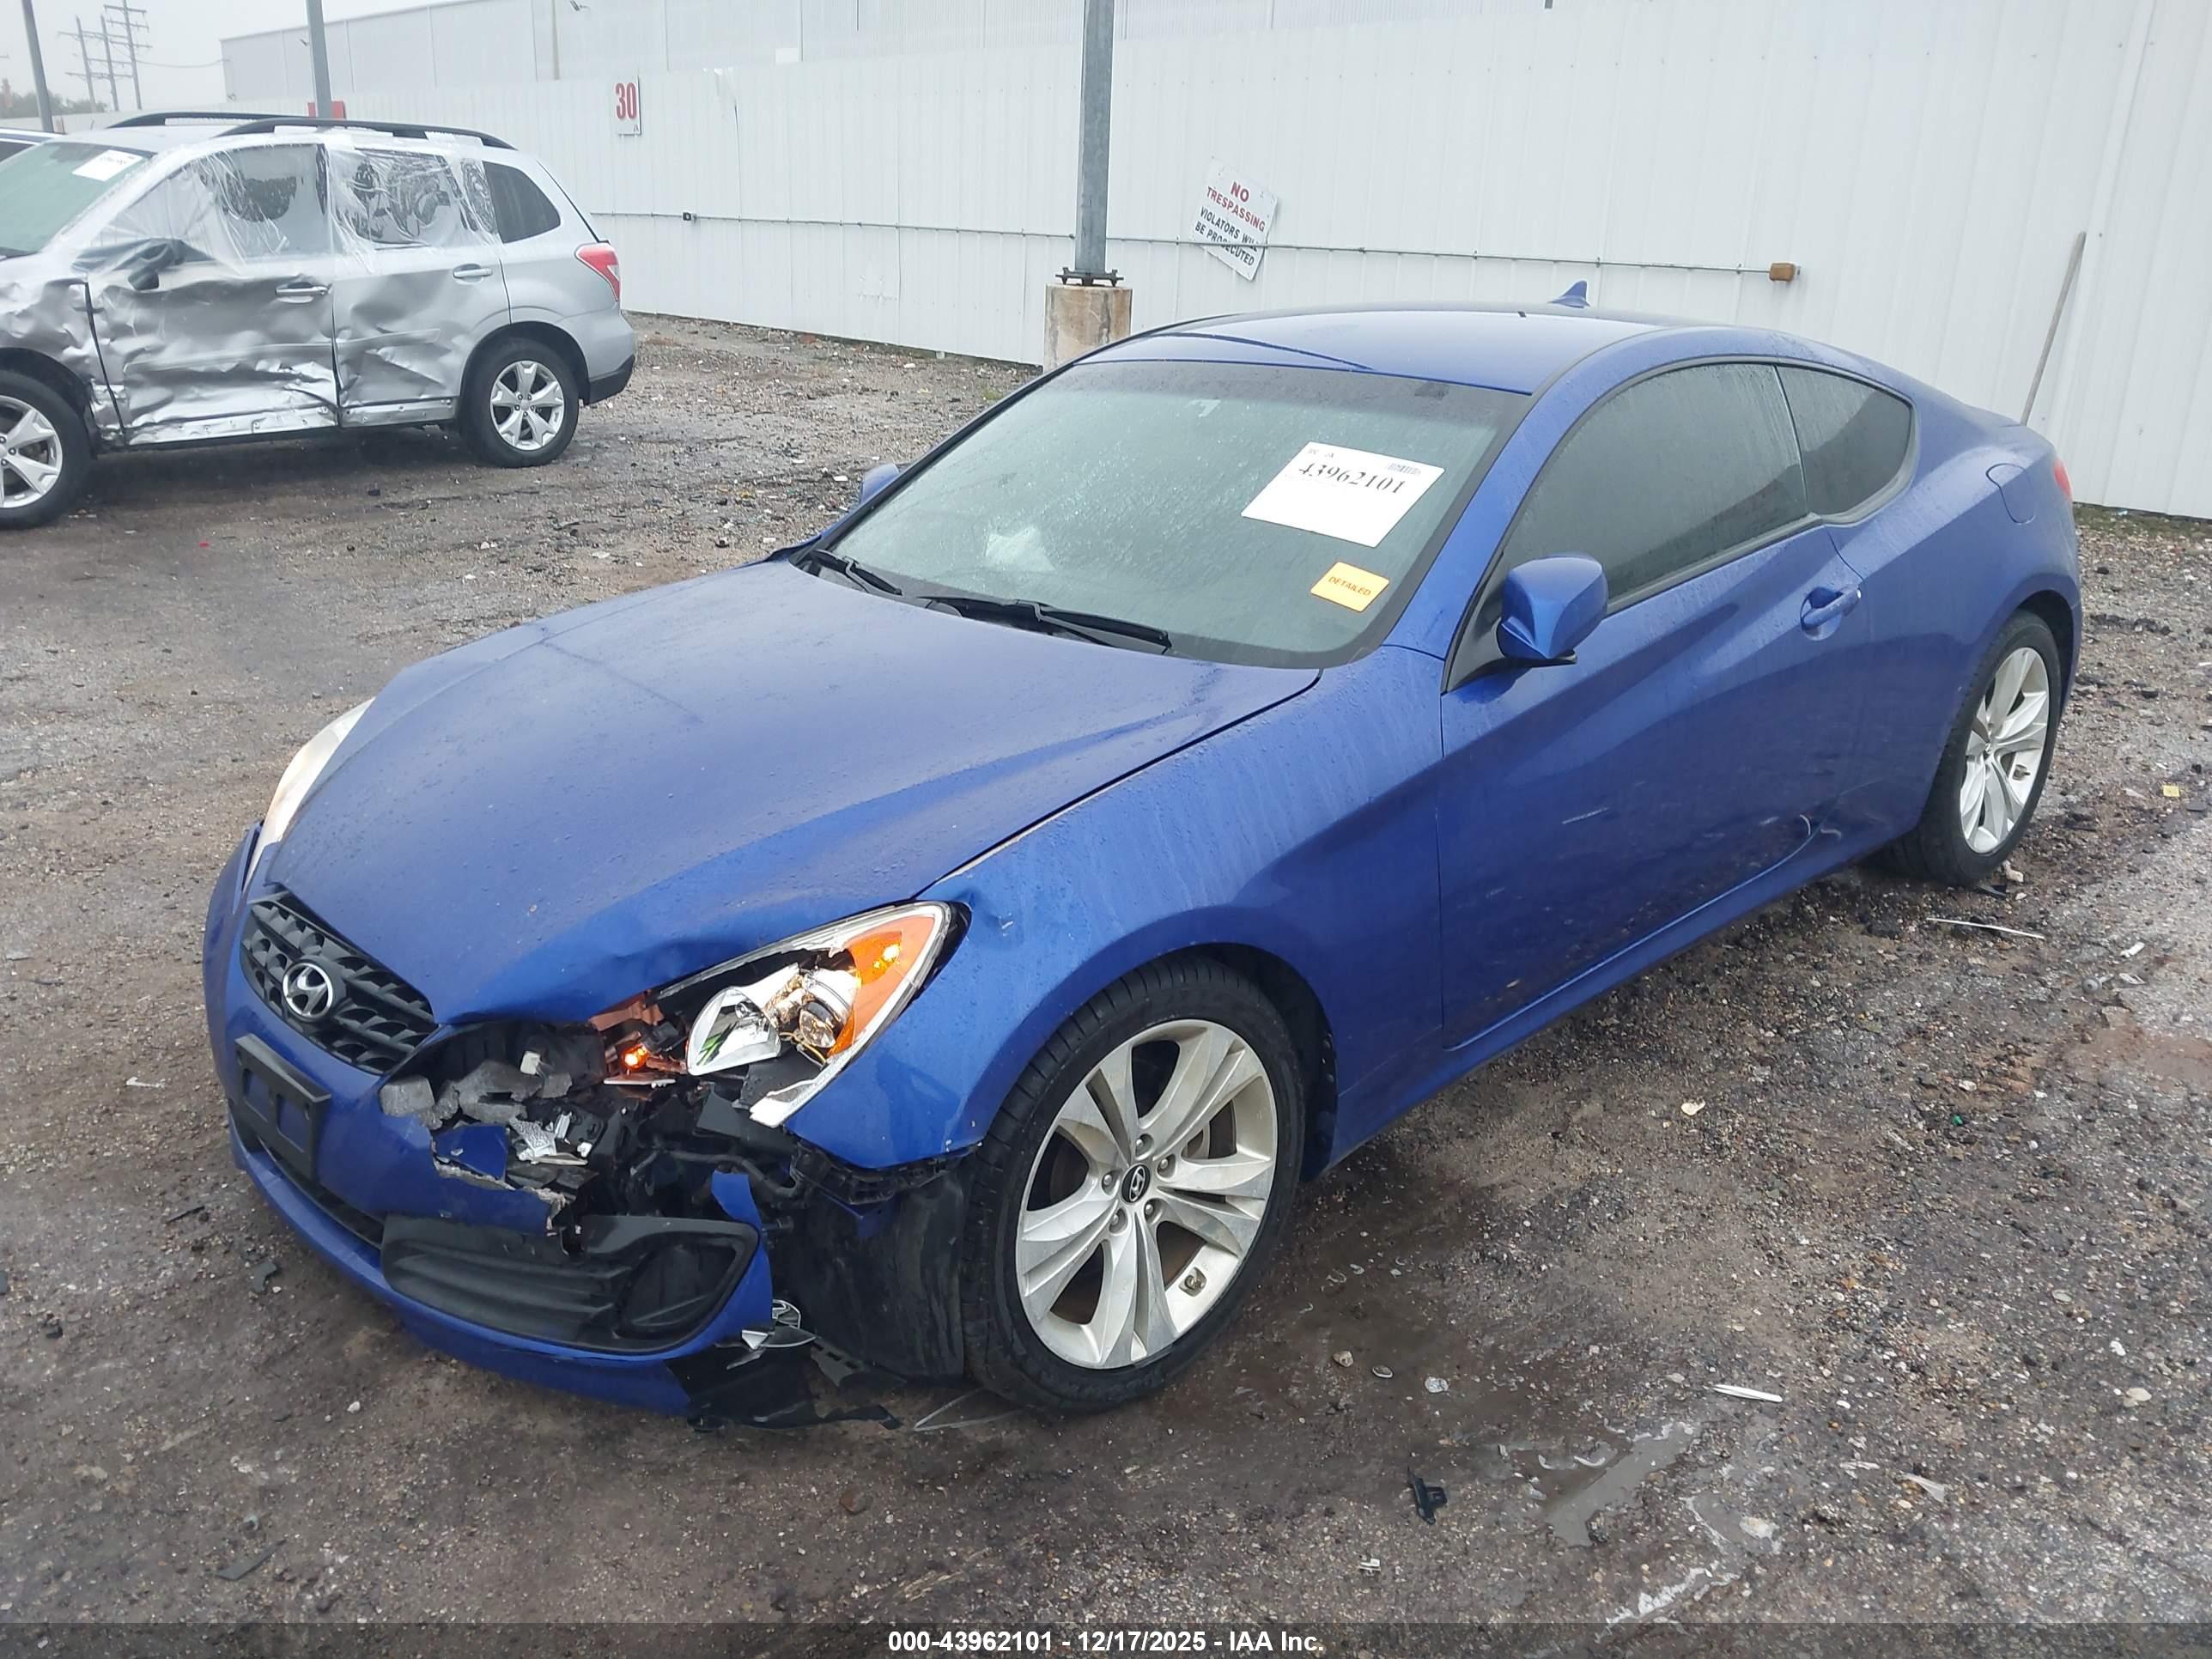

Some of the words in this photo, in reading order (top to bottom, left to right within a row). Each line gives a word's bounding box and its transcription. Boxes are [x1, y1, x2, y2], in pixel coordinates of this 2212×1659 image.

[616, 82, 637, 119] 30
[1230, 180, 1249, 203] NO
[1200, 206, 1241, 240] VIOLATORS
[1206, 185, 1266, 233] TRESPASSING
[1194, 221, 1206, 234] BE
[1298, 463, 1406, 494] 43962101
[1328, 576, 1371, 597] DETAILED
